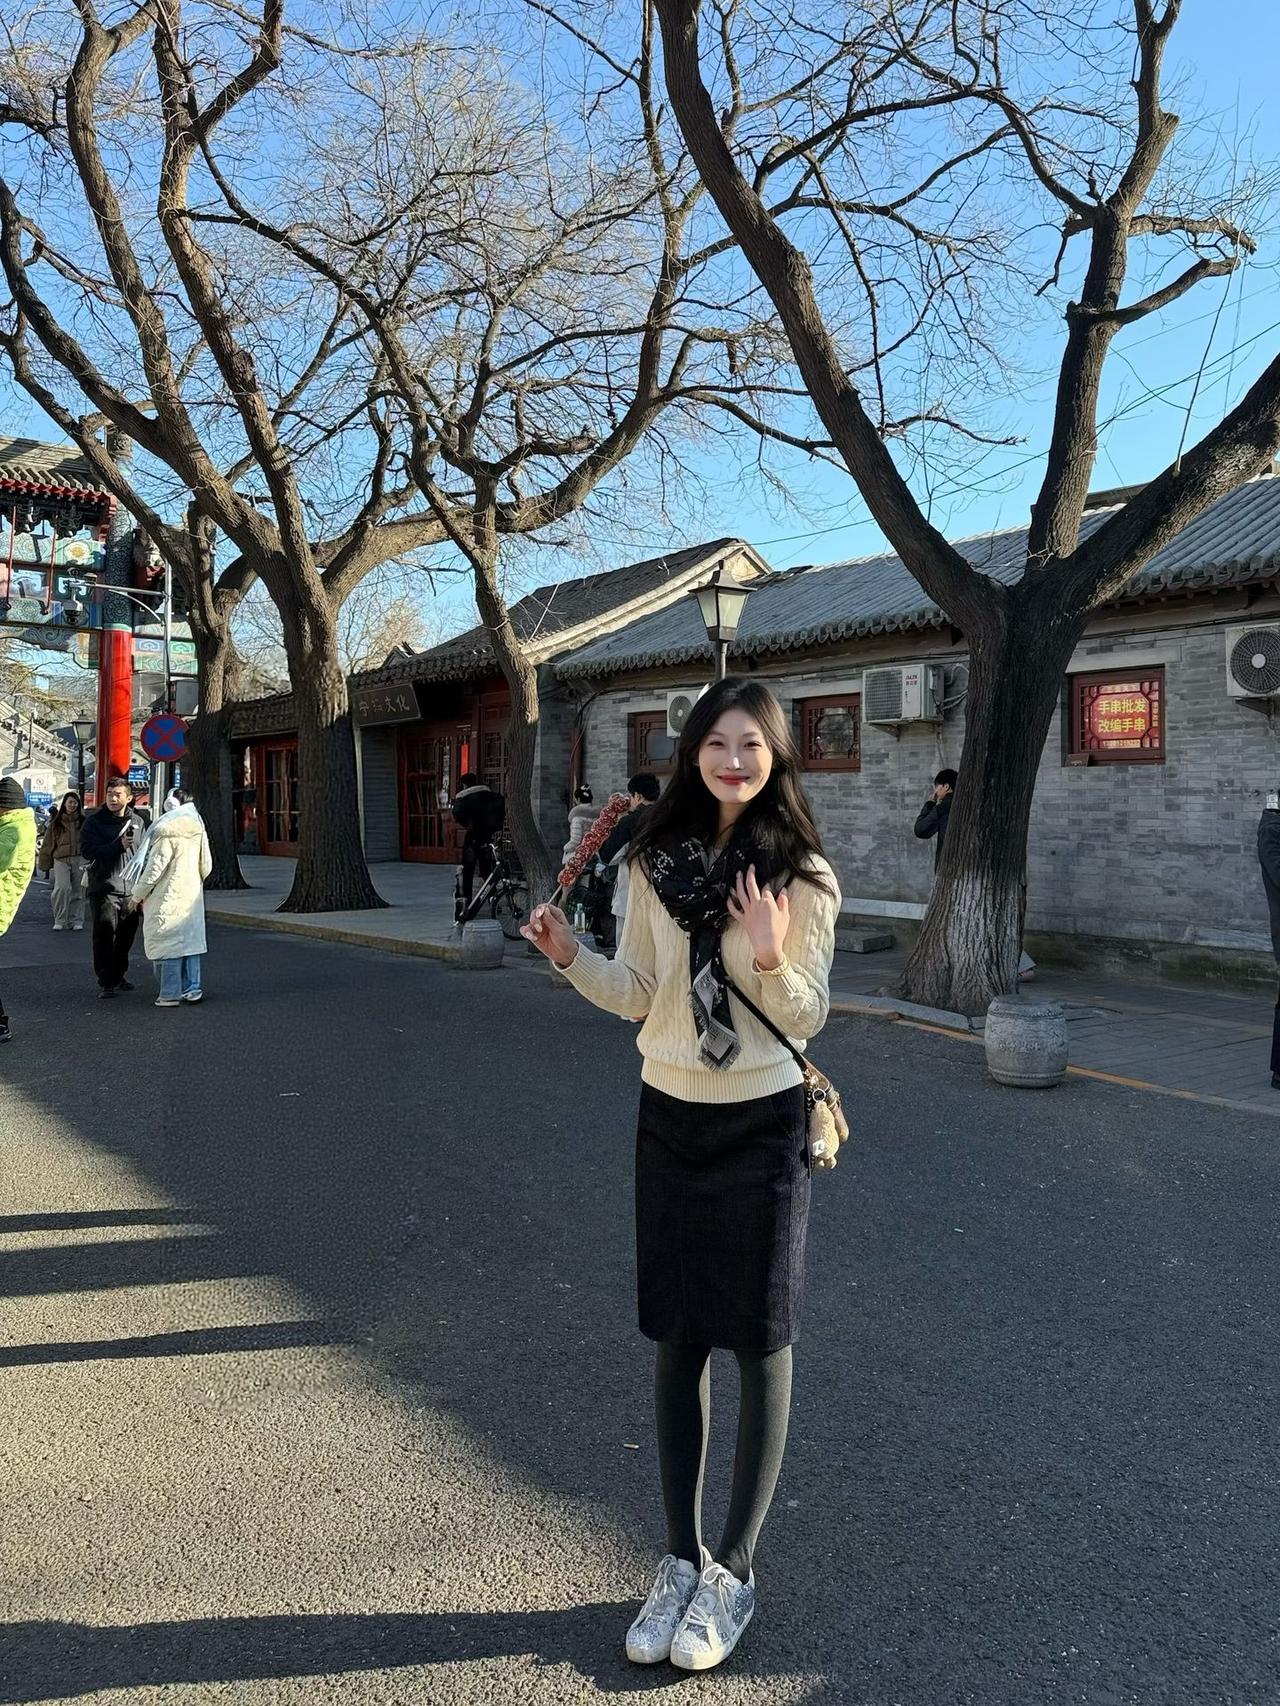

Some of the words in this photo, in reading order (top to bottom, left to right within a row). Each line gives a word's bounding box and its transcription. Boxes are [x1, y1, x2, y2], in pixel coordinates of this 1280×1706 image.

[1098, 698, 1145, 714] 手串批发
[1098, 718, 1145, 732] 改编手串
